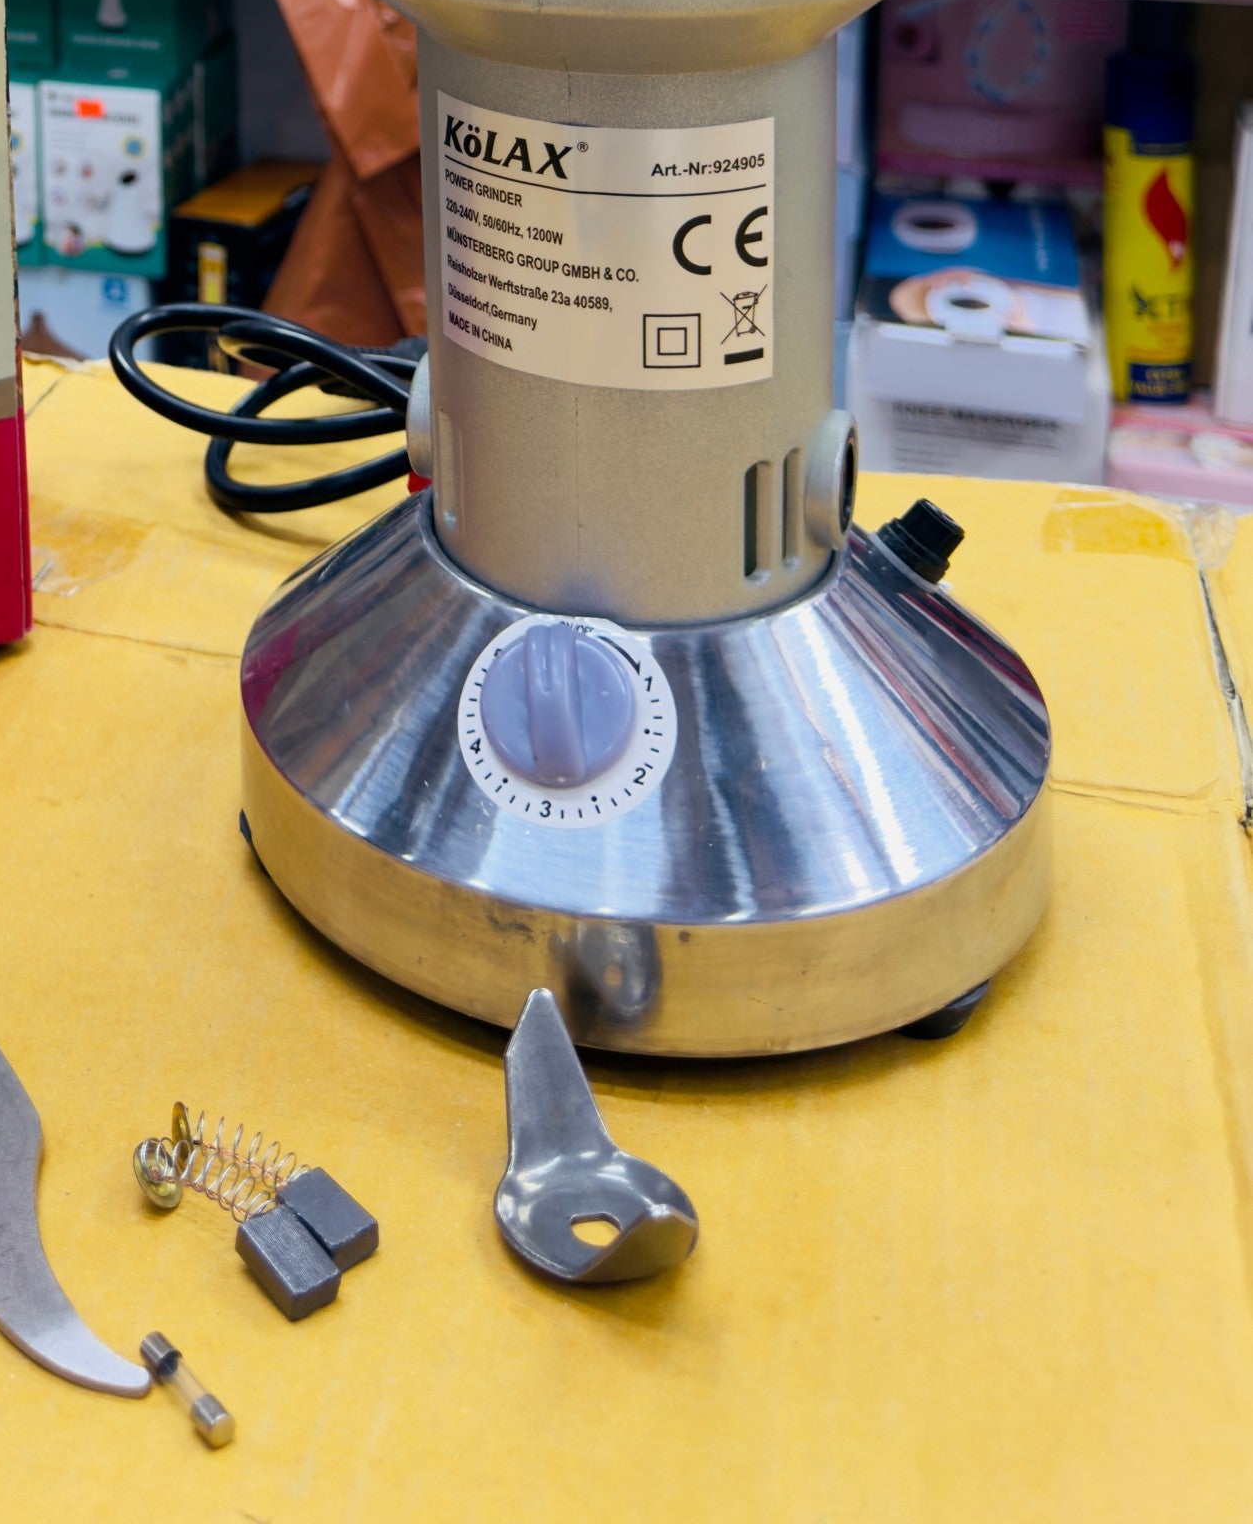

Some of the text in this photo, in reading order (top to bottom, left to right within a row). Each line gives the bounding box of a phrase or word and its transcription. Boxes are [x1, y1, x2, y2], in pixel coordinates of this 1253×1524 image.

[651, 153, 765, 177] Art.-Nr:924905
[444, 169, 523, 207] POWER GRINDER
[445, 197, 563, 245] 220-240V, 50/60Hz, 1200W
[673, 206, 768, 276] CE
[447, 225, 639, 282] MÜNSTERBERG GROUP GMBH & CO.
[551, 290, 571, 306] 23a
[573, 295, 613, 313] 40589,
[449, 311, 513, 351] MADE IN CHINA
[644, 675, 653, 692] 1
[470, 738, 481, 754] 4
[633, 768, 646, 785] 2
[540, 801, 552, 818] 3
